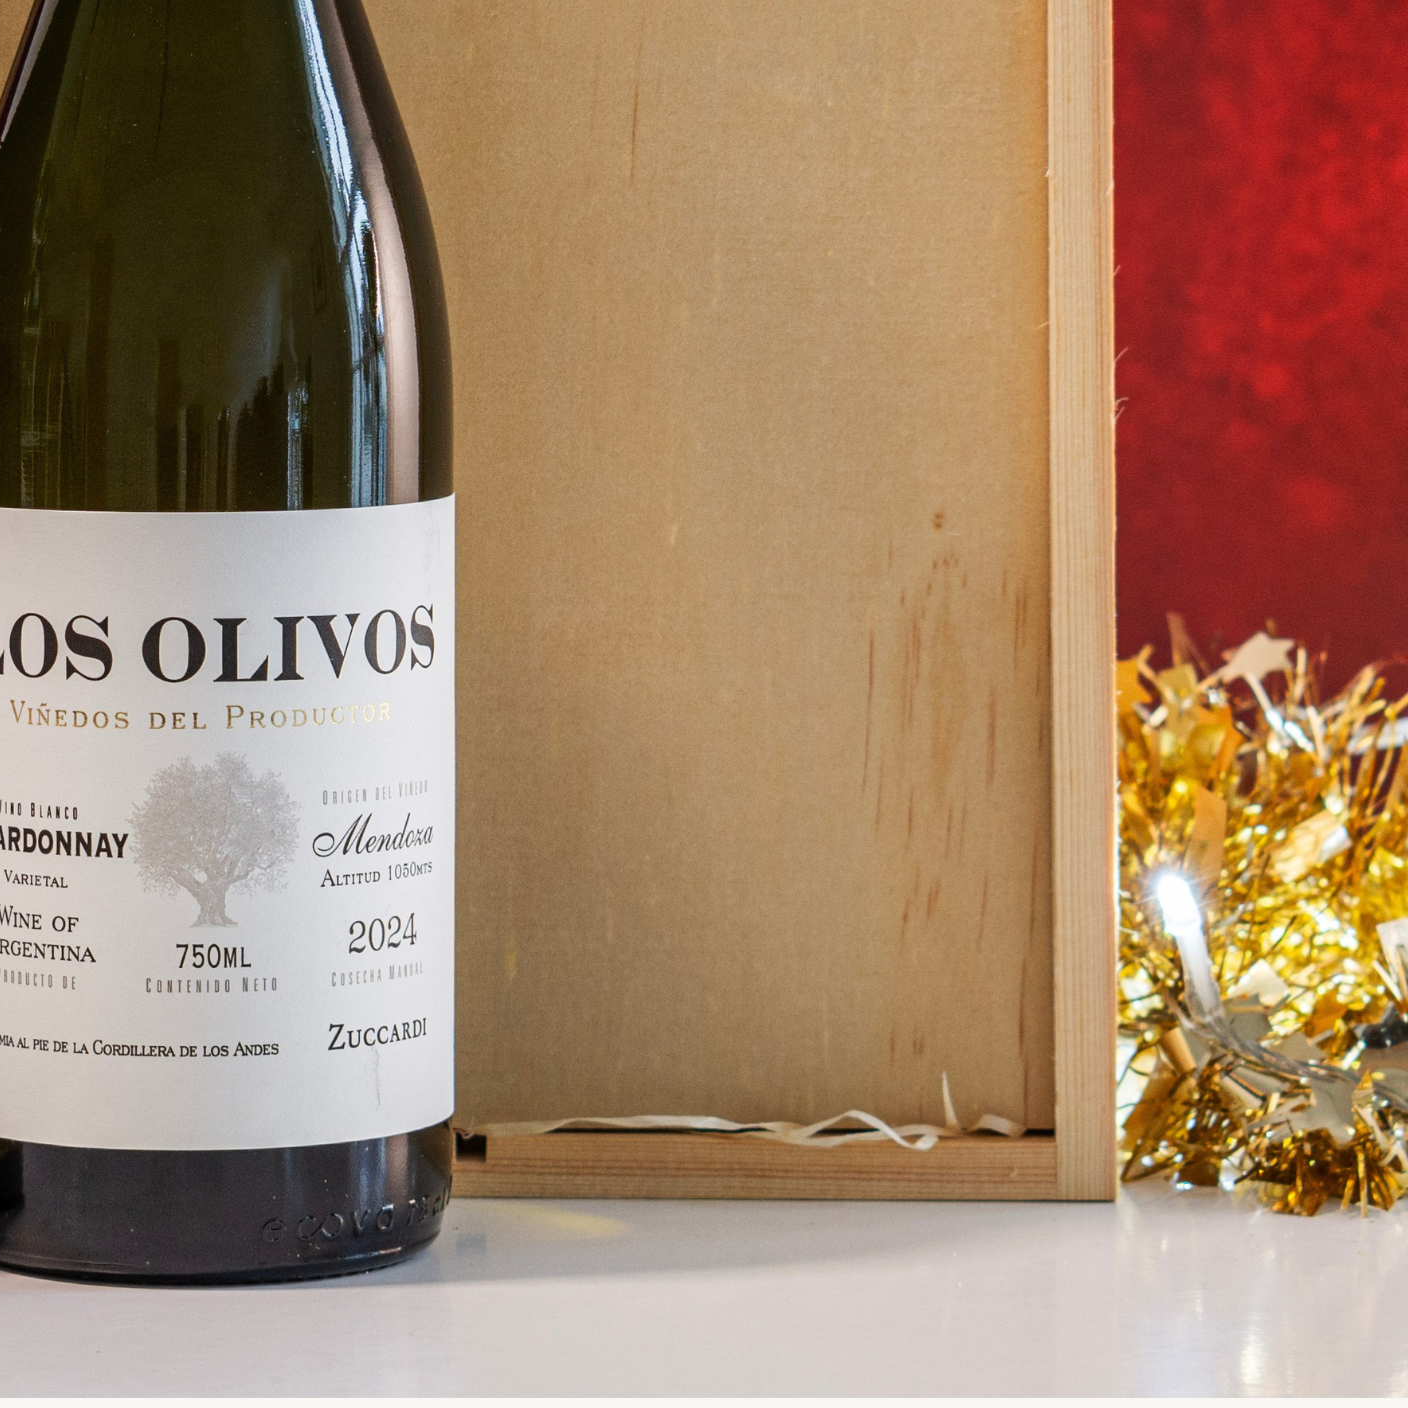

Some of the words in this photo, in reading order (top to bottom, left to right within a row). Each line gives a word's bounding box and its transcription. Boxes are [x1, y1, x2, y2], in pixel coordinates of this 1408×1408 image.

[141, 603, 435, 684] OLIVOS
[311, 812, 434, 858] Mendoza
[175, 942, 252, 969] 750ML
[348, 912, 418, 955] 2024
